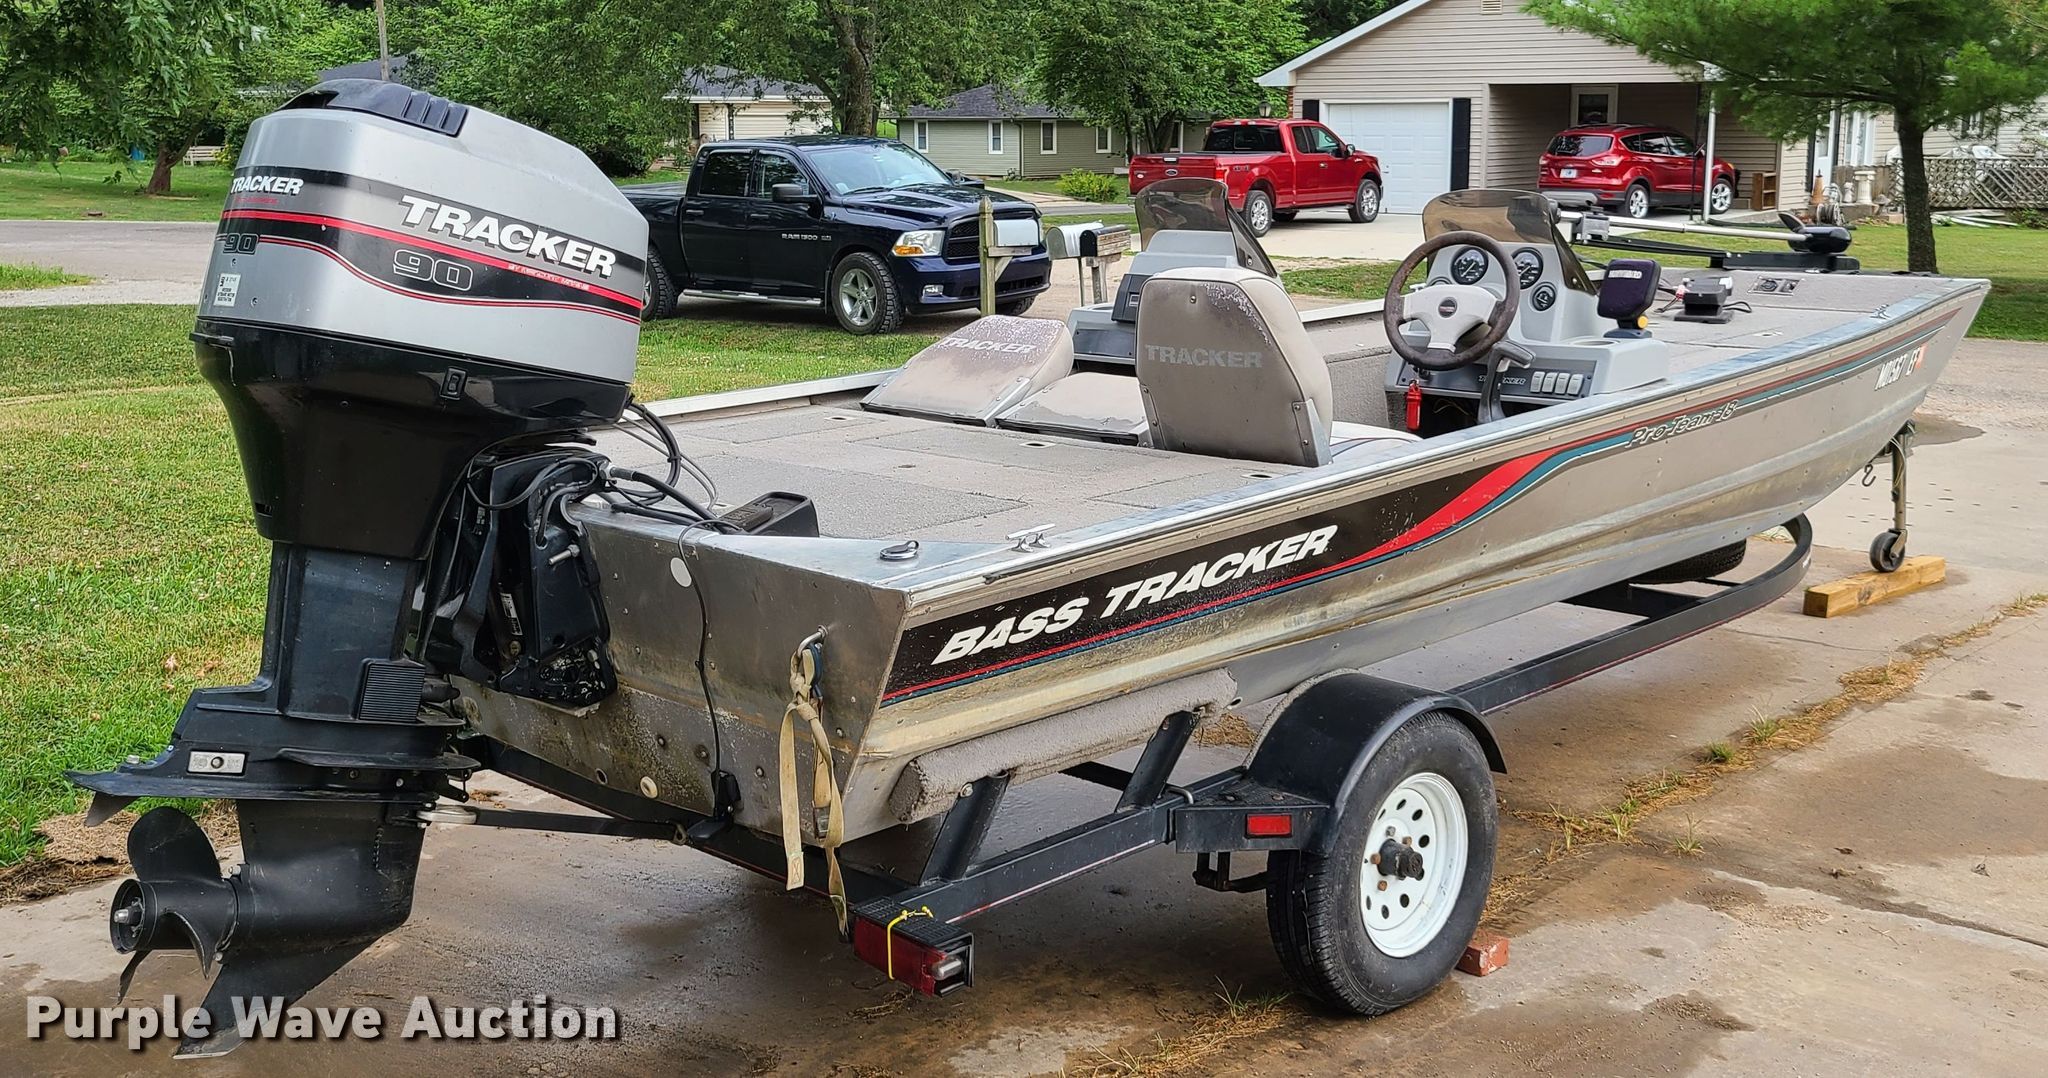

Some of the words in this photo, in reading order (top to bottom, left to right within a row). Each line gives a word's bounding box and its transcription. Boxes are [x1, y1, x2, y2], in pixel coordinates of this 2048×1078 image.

[230, 175, 304, 195] TRACKER
[222, 233, 259, 254] 90
[400, 195, 616, 279] TRACKER
[393, 249, 473, 291] 90
[940, 336, 1037, 354] TRACKER
[1144, 344, 1264, 369] TRACKER
[930, 596, 1090, 666] BASS
[1100, 524, 1339, 619] TRACKER
